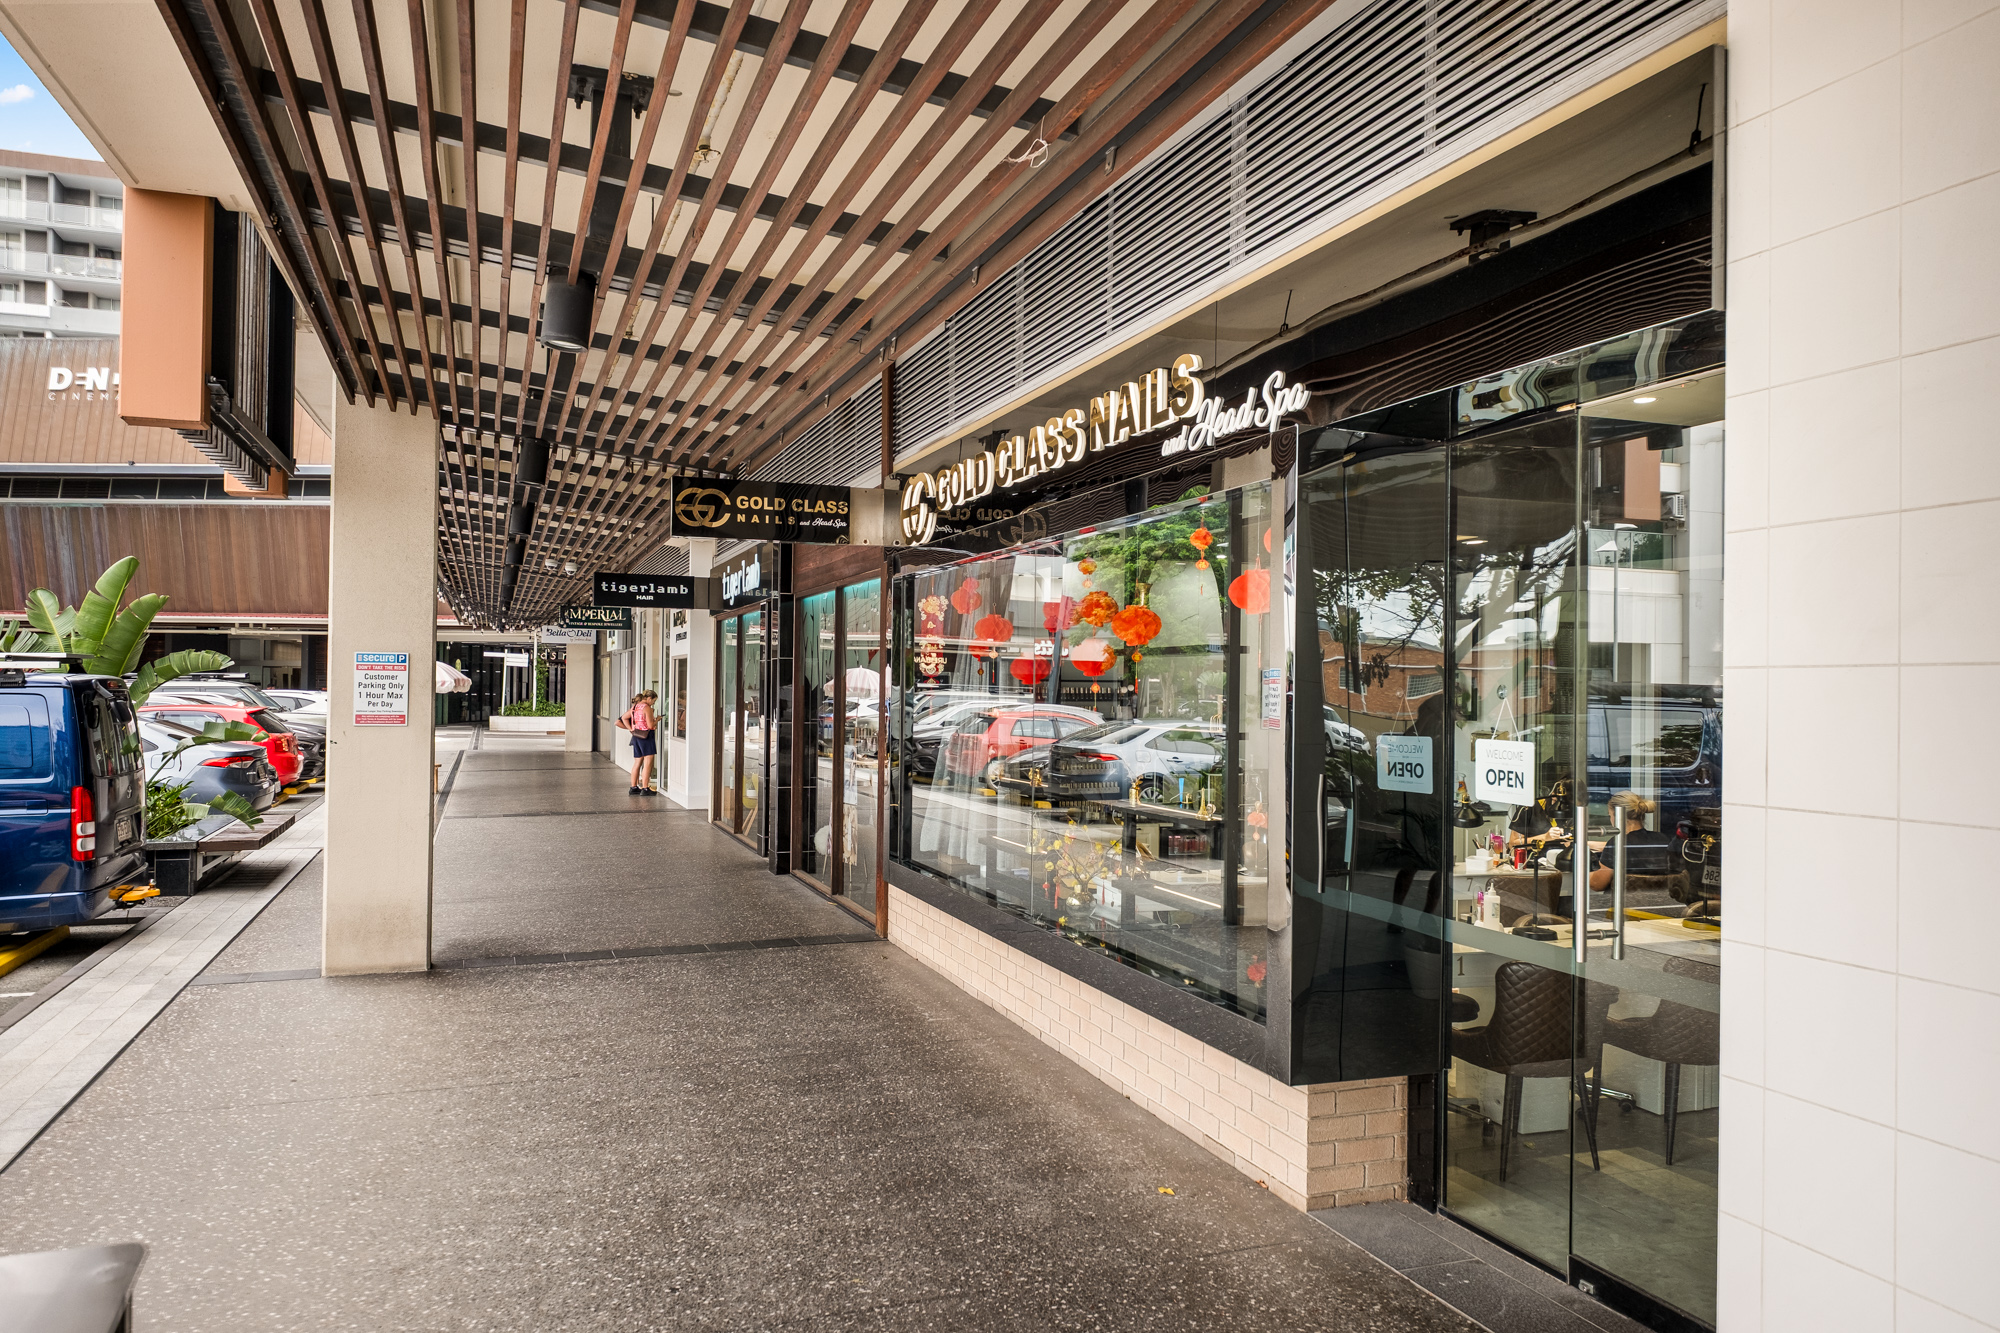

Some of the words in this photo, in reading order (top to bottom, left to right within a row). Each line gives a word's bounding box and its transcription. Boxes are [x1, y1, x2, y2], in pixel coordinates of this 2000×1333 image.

[1162, 425, 1190, 457] and
[1188, 386, 1258, 451] Head
[1255, 370, 1312, 432] Spa
[936, 452, 995, 511] GOLD
[995, 408, 1087, 488] CLASS
[1090, 353, 1204, 452] NAILS
[736, 495, 786, 511] GOLD
[791, 498, 849, 515] CLASS
[736, 513, 796, 526] NAILS
[812, 518, 833, 527] Head
[832, 518, 848, 528] Spa
[722, 553, 760, 606] tigerlamb
[601, 581, 689, 595] tigerlamb
[546, 628, 567, 637] Bella
[575, 629, 592, 637] Deli
[363, 654, 395, 662] secure
[398, 654, 405, 662] P
[358, 682, 386, 690] Parking
[388, 682, 405, 690] Only
[1486, 749, 1524, 761] WELCOME
[1485, 768, 1524, 789] OPEN
[1466, 877, 1473, 892] 7
[1457, 955, 1465, 976] 1
